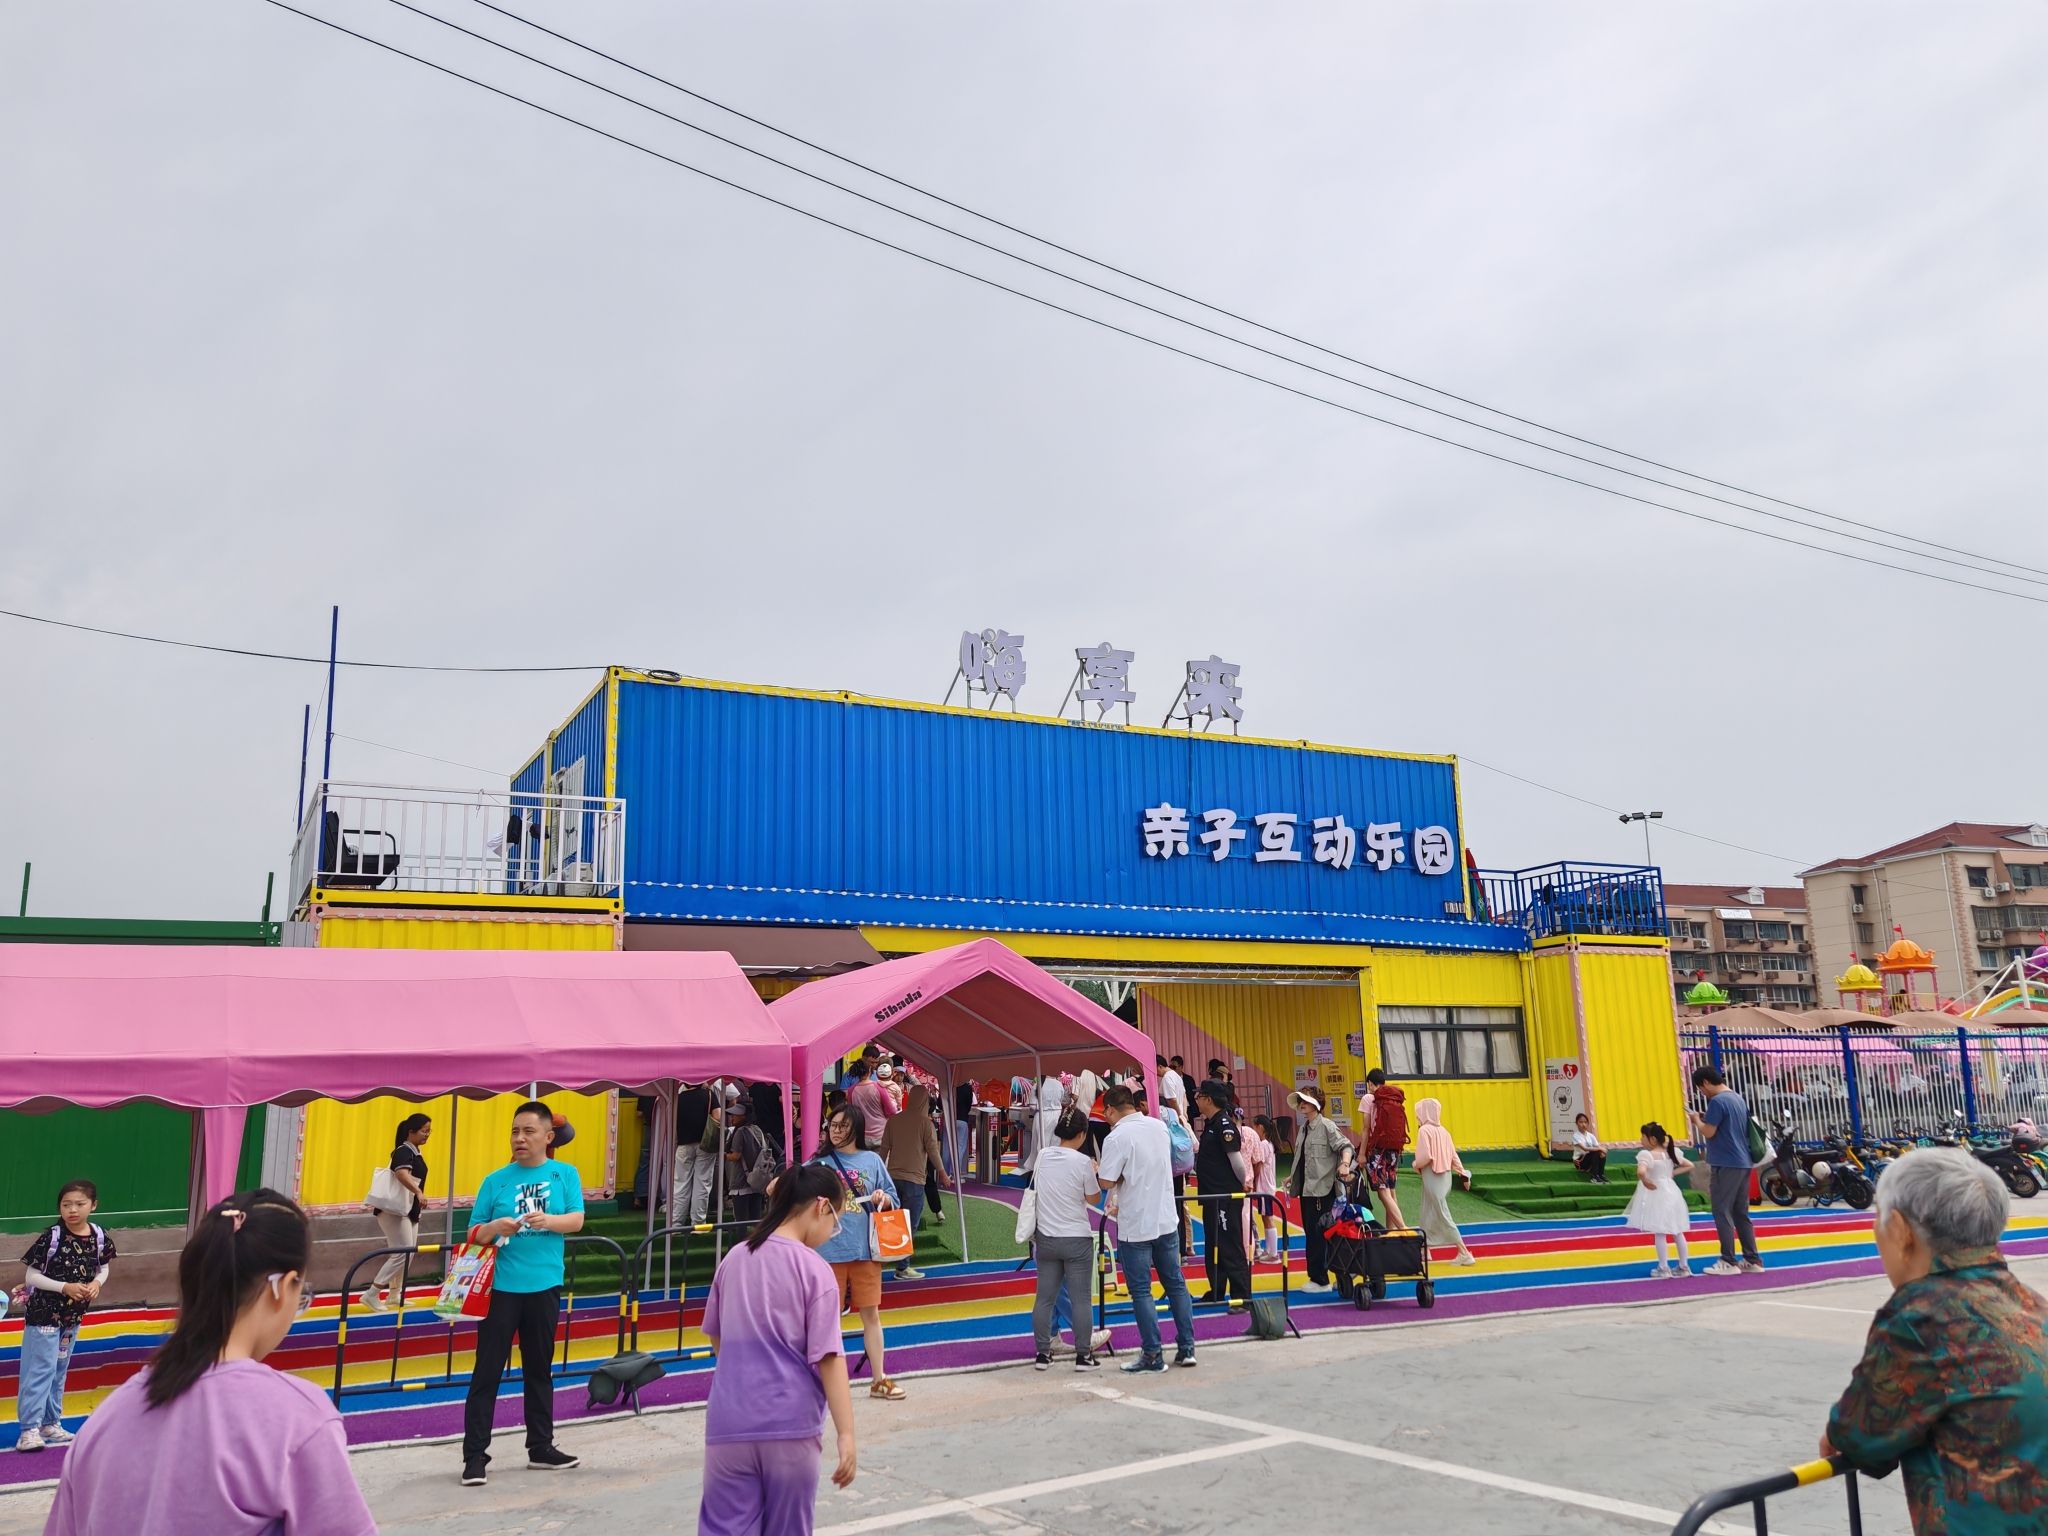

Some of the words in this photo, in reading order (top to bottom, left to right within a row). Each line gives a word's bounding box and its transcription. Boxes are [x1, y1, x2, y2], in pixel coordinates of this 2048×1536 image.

[959, 628, 1244, 721] 嗨享来
[1143, 802, 1455, 875] 亲子互动乐园
[874, 990, 923, 1023] Sibada
[521, 1183, 543, 1198] WE
